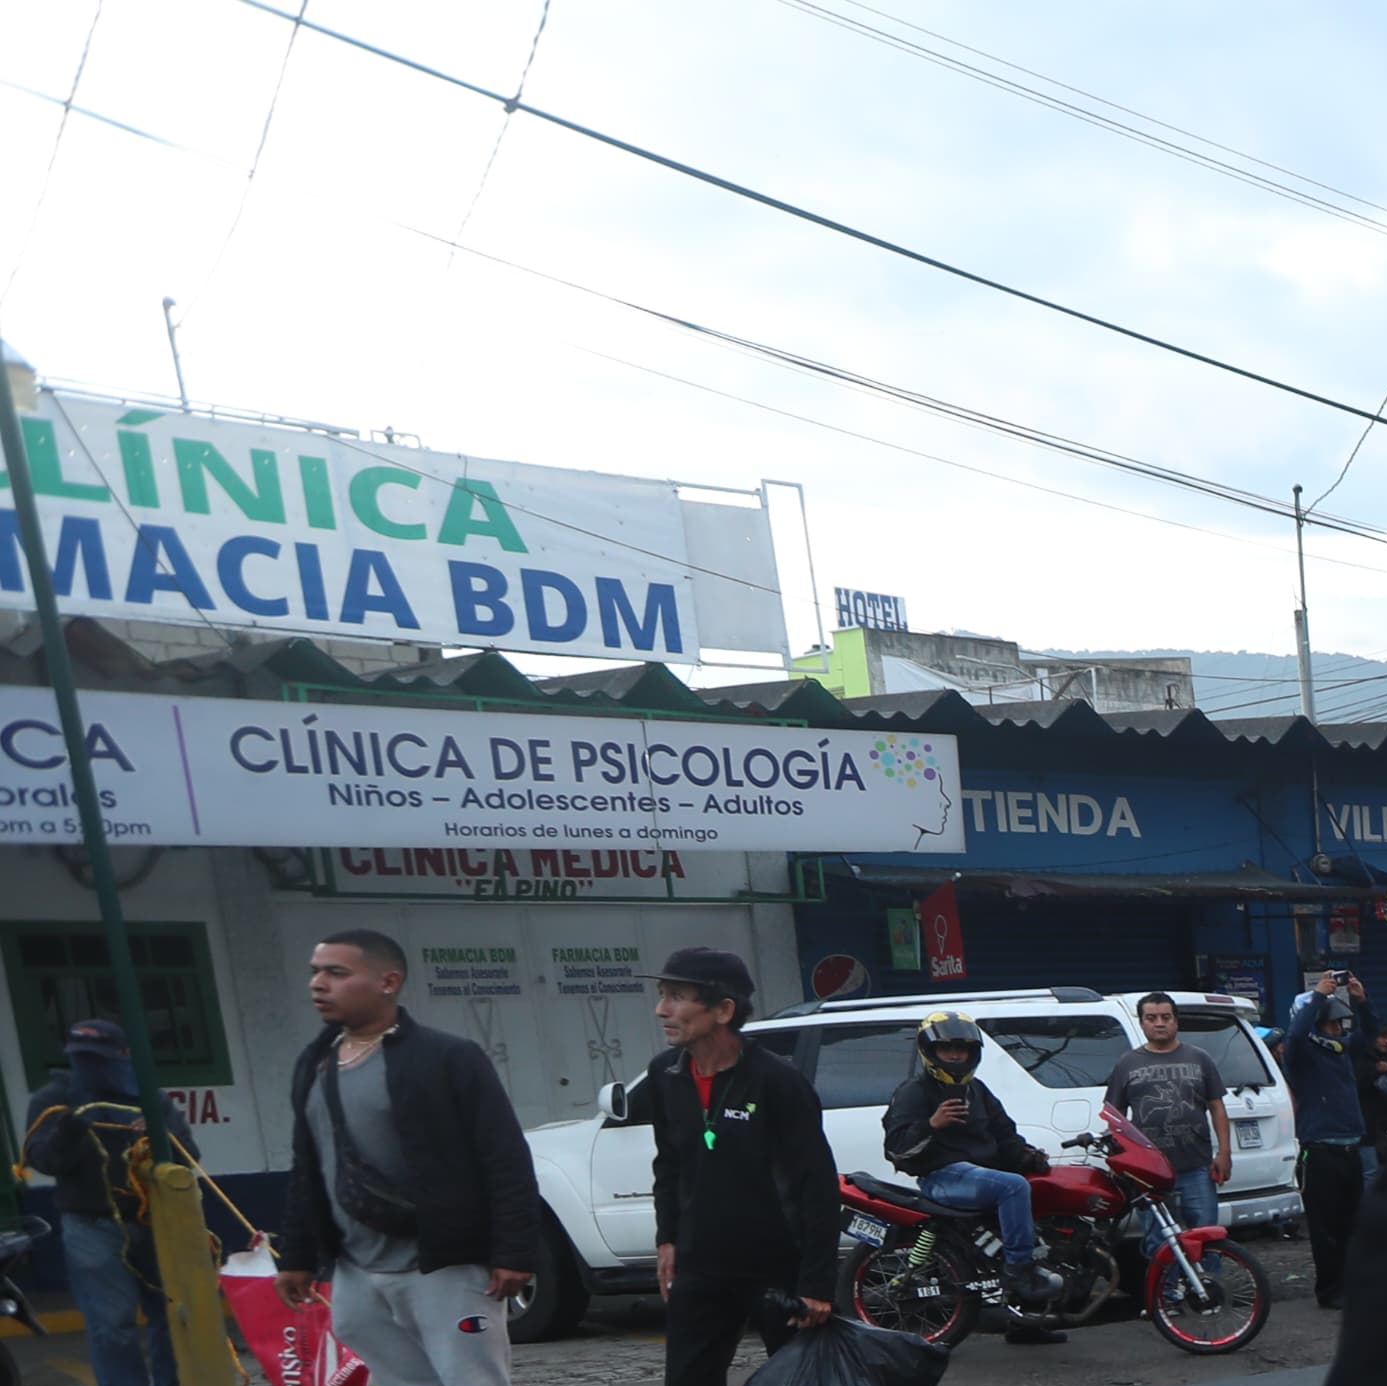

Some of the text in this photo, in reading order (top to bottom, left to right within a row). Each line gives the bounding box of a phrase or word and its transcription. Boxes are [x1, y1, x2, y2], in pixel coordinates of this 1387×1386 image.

[0, 409, 529, 555] LÍNICA
[447, 559, 684, 655] BDM
[834, 587, 908, 632] HOTEL
[229, 713, 867, 793] CLÍNICA DE PSICOLOGÍA
[328, 783, 804, 817] Niños Adolescentes Adultos
[963, 788, 1142, 839] TIENDA
[444, 822, 718, 843] Horarios de lunes a domingo
[421, 947, 487, 964] FARMACIA
[552, 947, 640, 963] FARMACIA BDM
[931, 954, 964, 978] Sarita
[723, 1108, 750, 1121] NCM
